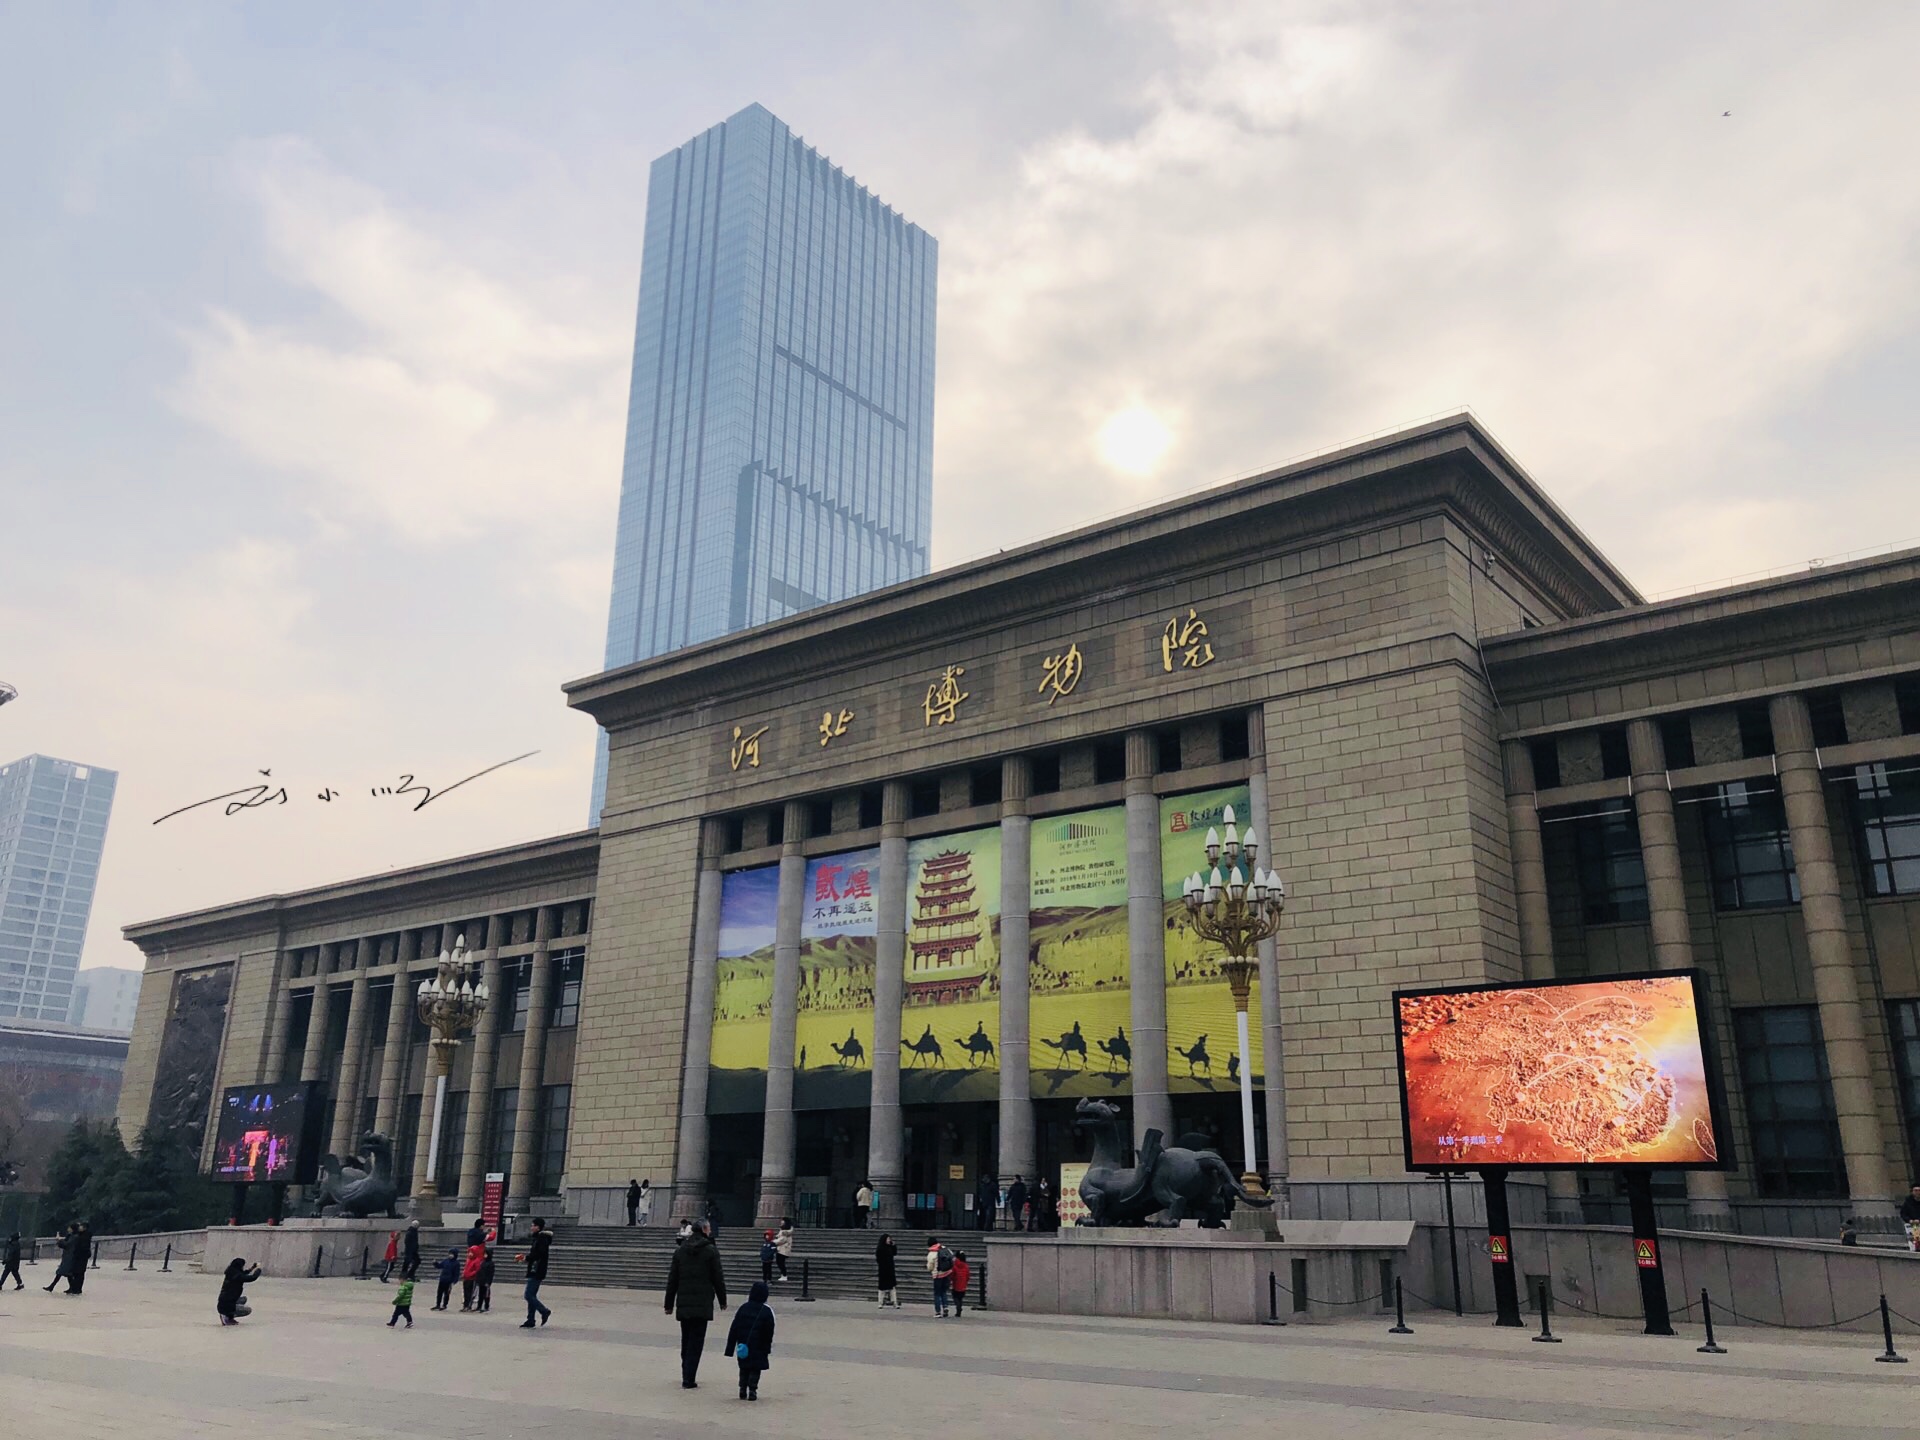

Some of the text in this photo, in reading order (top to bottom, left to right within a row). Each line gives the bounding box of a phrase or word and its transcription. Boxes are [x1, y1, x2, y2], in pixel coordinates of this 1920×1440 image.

[731, 608, 1215, 771] 河北博物院
[1190, 802, 1248, 823] 敦煌研院
[815, 864, 872, 902] 敦煌
[812, 900, 873, 919] 不再遥远
